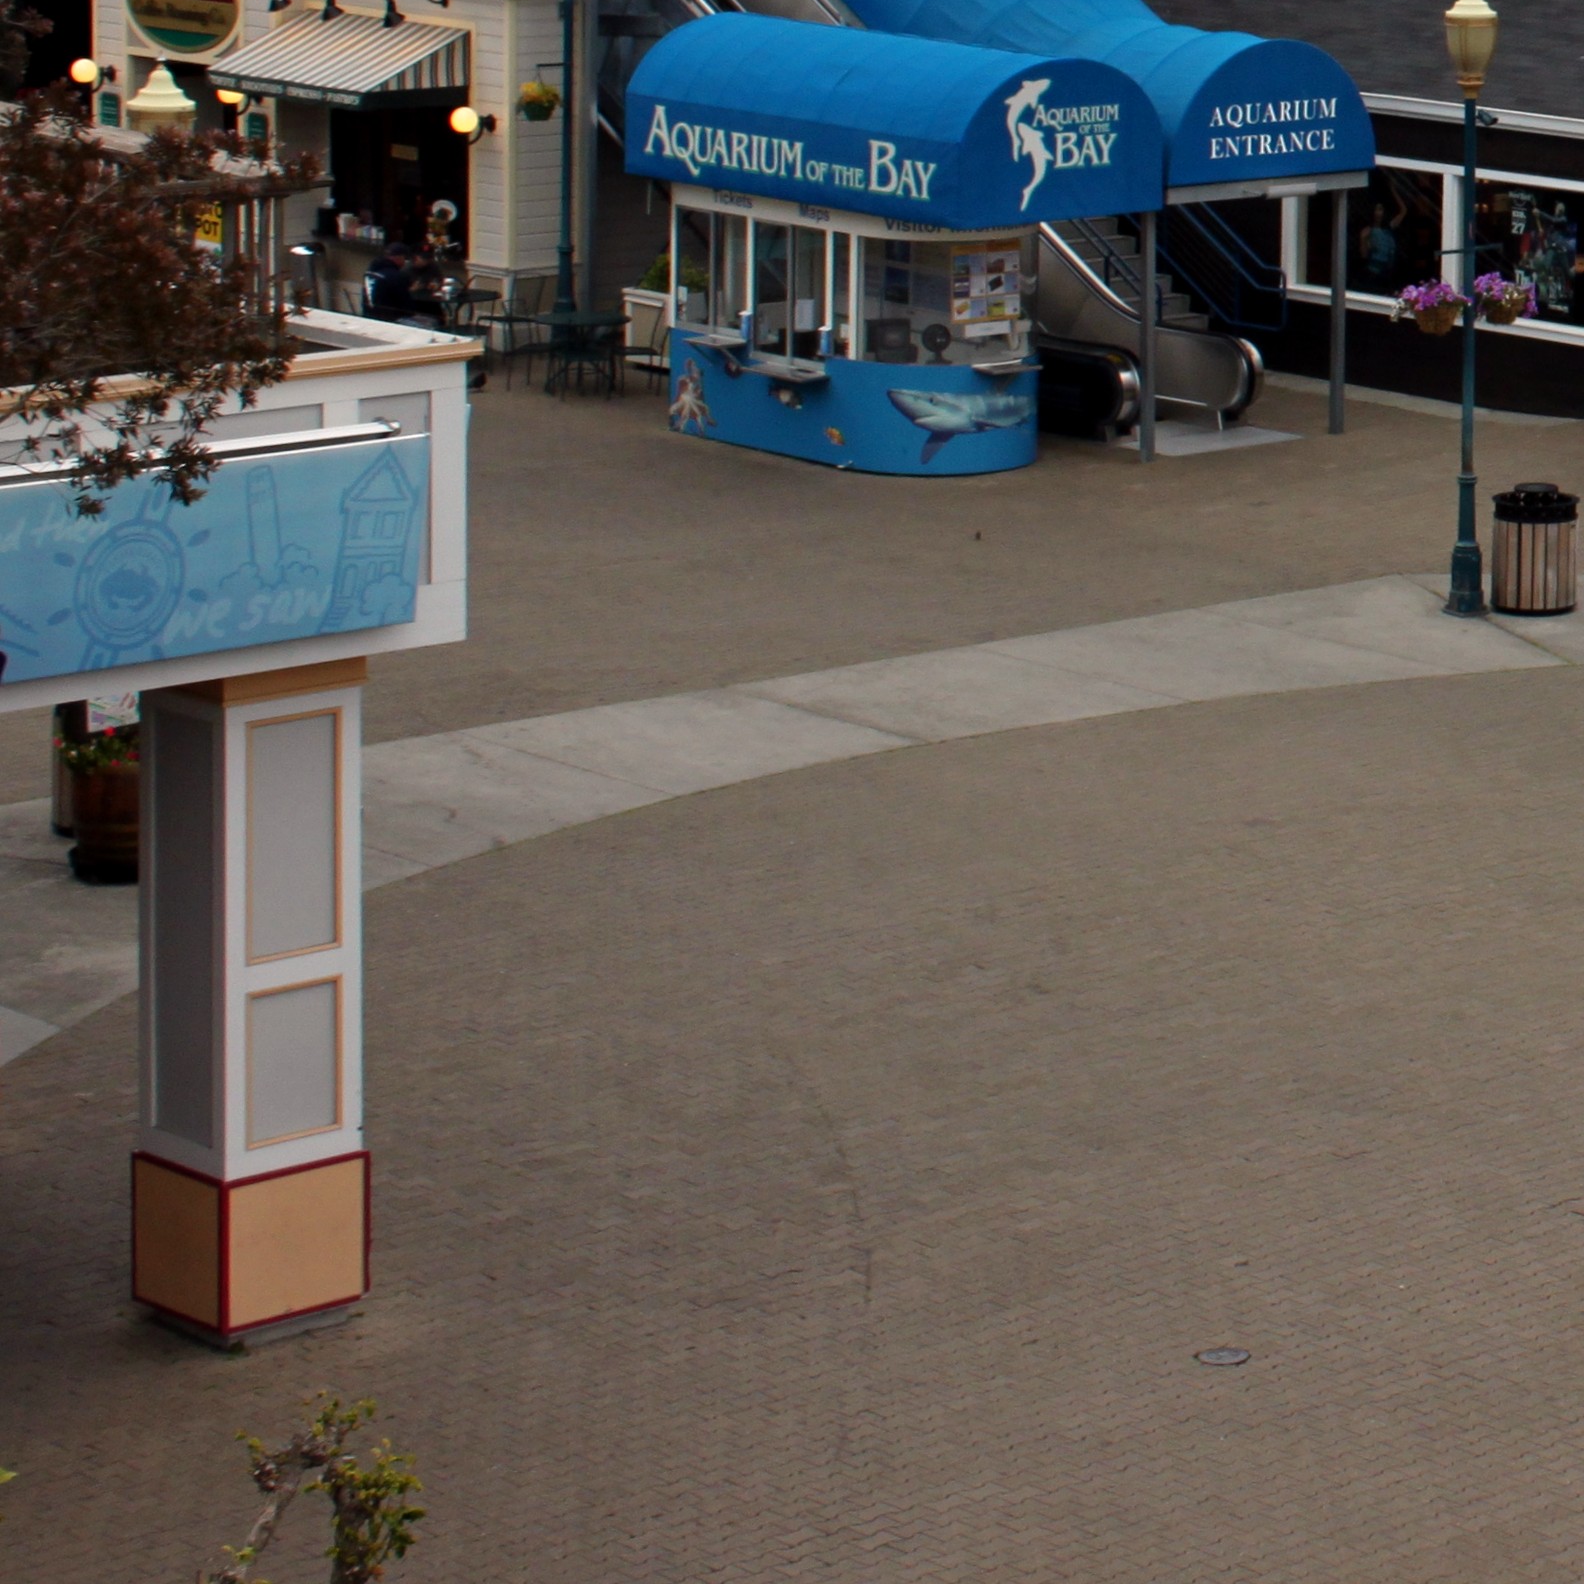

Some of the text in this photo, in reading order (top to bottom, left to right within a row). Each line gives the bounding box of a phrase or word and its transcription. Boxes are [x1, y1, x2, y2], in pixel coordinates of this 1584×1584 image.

[1033, 103, 1119, 130] AQUARIUM
[1209, 97, 1337, 128] AQUARIUM
[644, 104, 937, 200] AQUARIUM OF THE BAY
[1053, 132, 1118, 169] BAY
[1209, 129, 1335, 160] ENTRANCE
[711, 188, 754, 210] Tickets
[885, 216, 940, 234] Visitor
